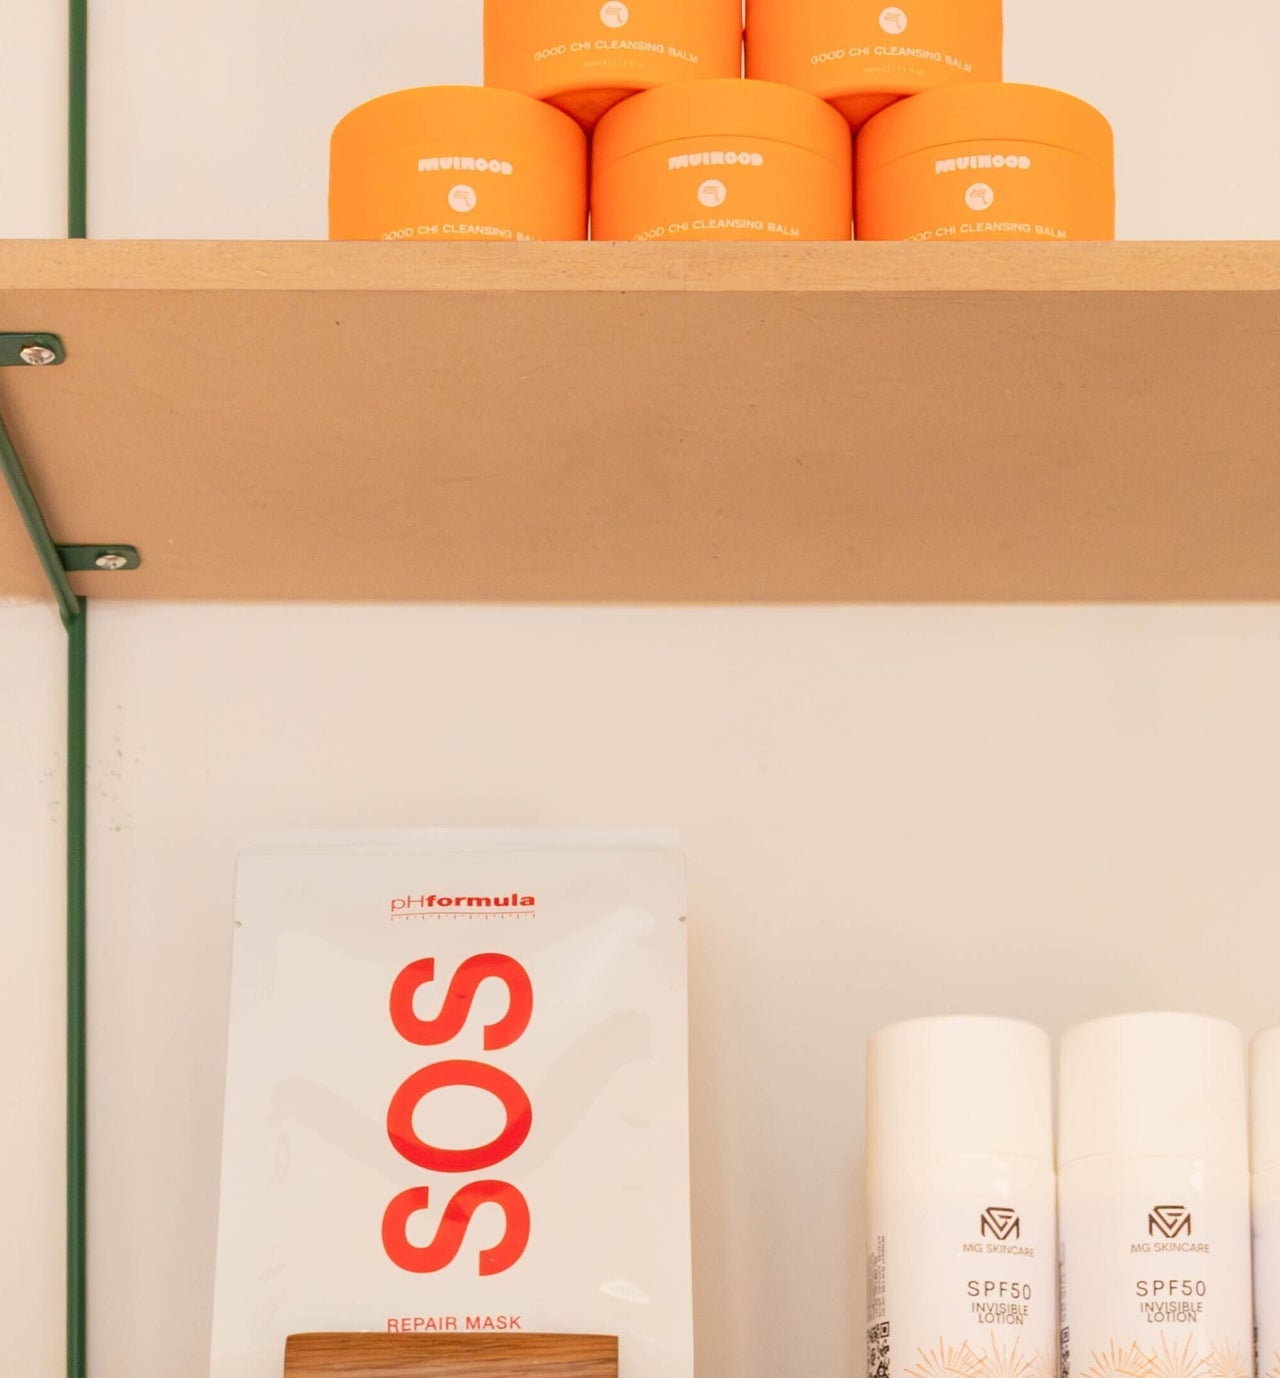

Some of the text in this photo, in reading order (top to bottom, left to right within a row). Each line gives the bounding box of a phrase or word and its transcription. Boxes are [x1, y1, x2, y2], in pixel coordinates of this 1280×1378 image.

[533, 39, 698, 64] GOOD CHI CLEANSING BALM
[810, 46, 972, 72] GOOD CHI CLEANSING BALM
[417, 225, 438, 235] CHI
[442, 224, 513, 239] CLEANSING
[667, 222, 689, 233] CHI
[692, 219, 764, 231] CLEANSING
[767, 222, 799, 237] BALM
[903, 222, 1067, 241] OOD CHI CLEANSING BALM
[391, 893, 535, 912] pHformula
[382, 952, 534, 1277] SOS
[962, 1243, 1035, 1258] MG SKINCARE
[1130, 1242, 1210, 1254] MG SKINCARE
[967, 1280, 1032, 1300] SPF50
[1136, 1280, 1206, 1297] SPF50
[971, 1302, 1029, 1316] INVISIBLE
[1140, 1301, 1203, 1313] INVISIBLE
[387, 1315, 522, 1333] REPAIR MASK
[978, 1312, 1024, 1326] LOTION
[1147, 1311, 1197, 1323] LOTION
